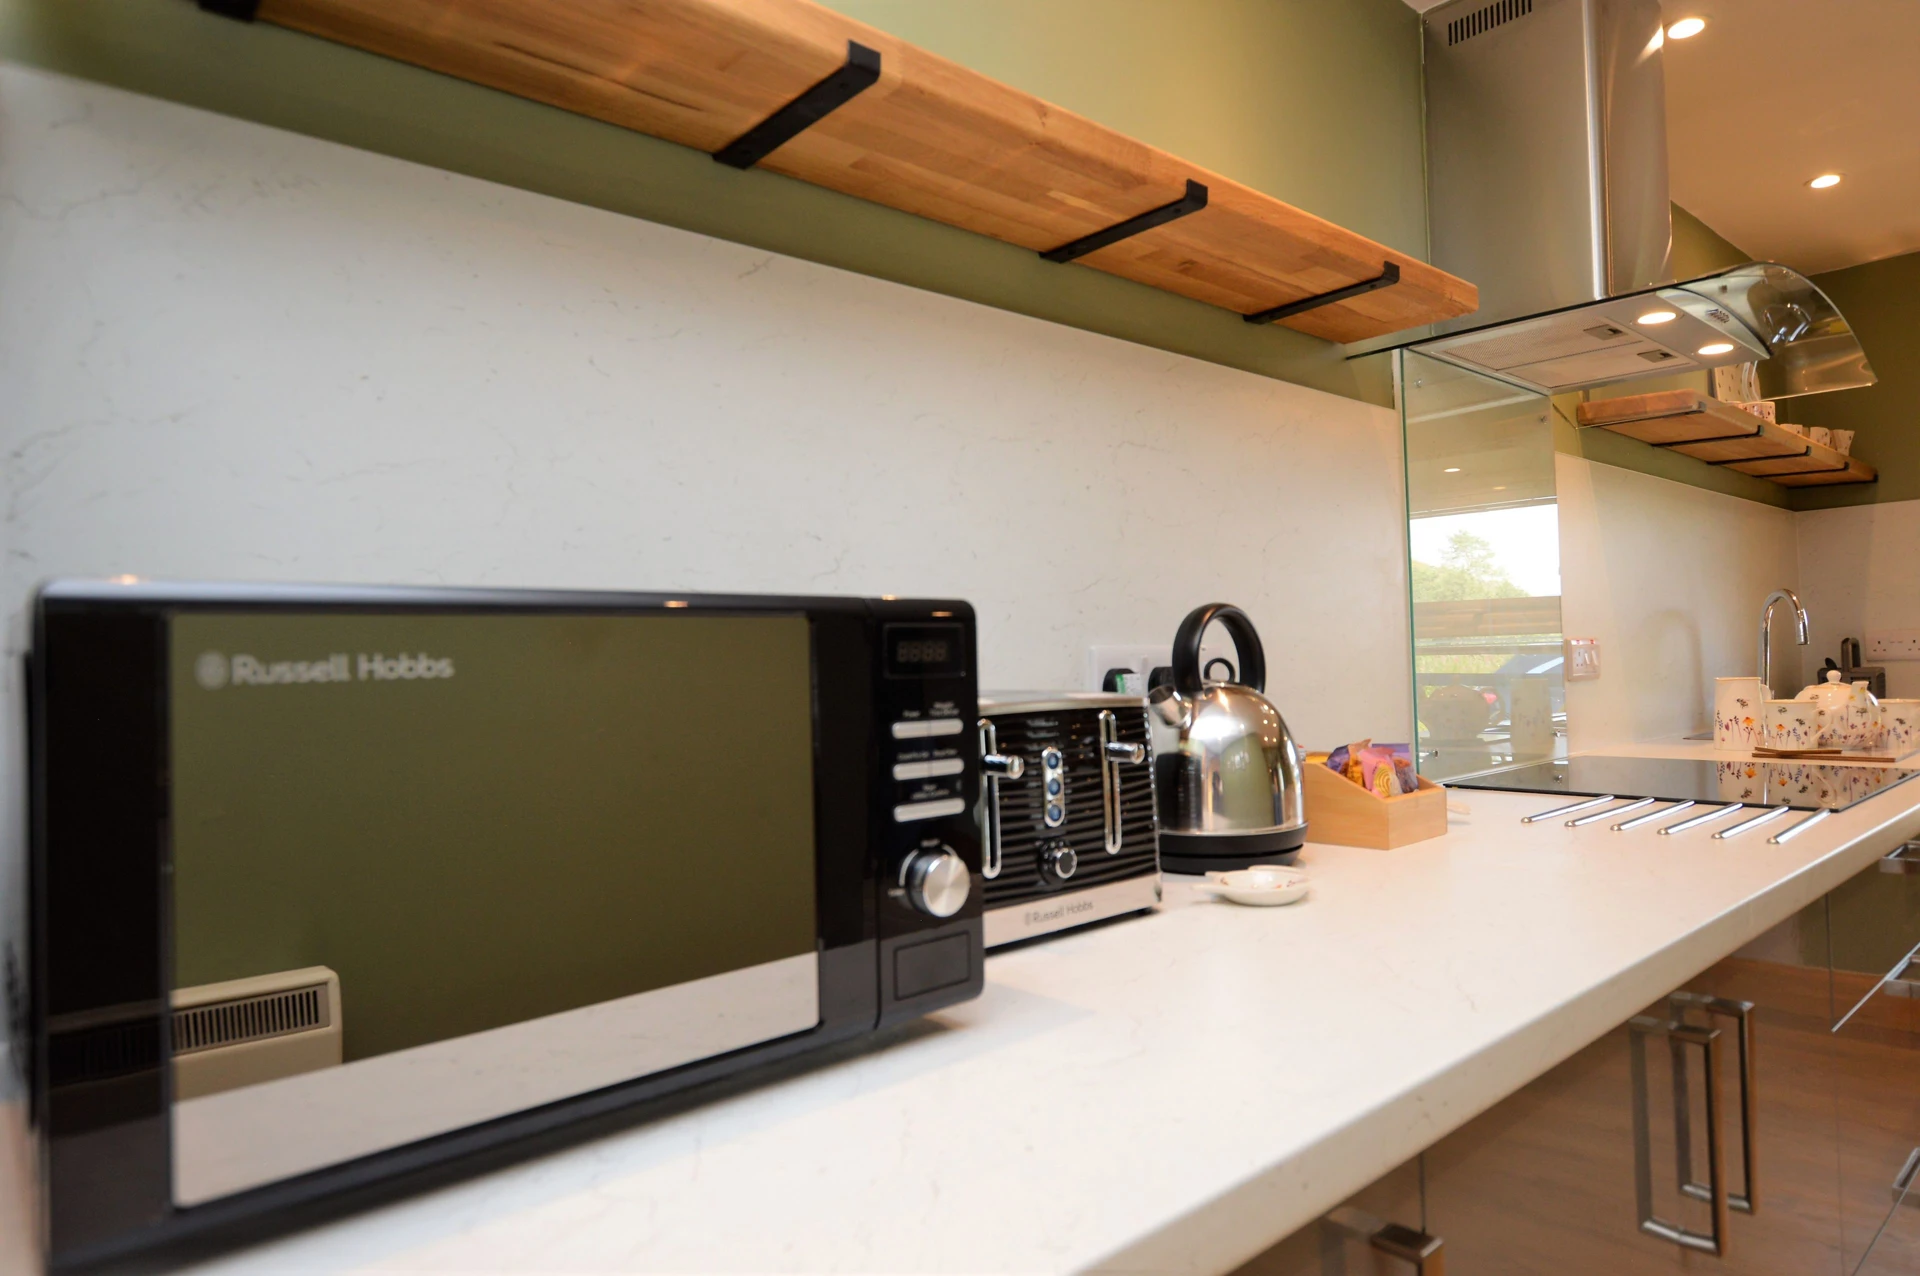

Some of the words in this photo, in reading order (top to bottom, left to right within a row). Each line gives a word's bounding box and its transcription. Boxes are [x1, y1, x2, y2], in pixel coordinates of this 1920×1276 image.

[231, 654, 350, 685] Russell
[357, 652, 455, 681] Hobbs
[1033, 905, 1065, 922] Russell
[1066, 901, 1093, 916] Hobbs
